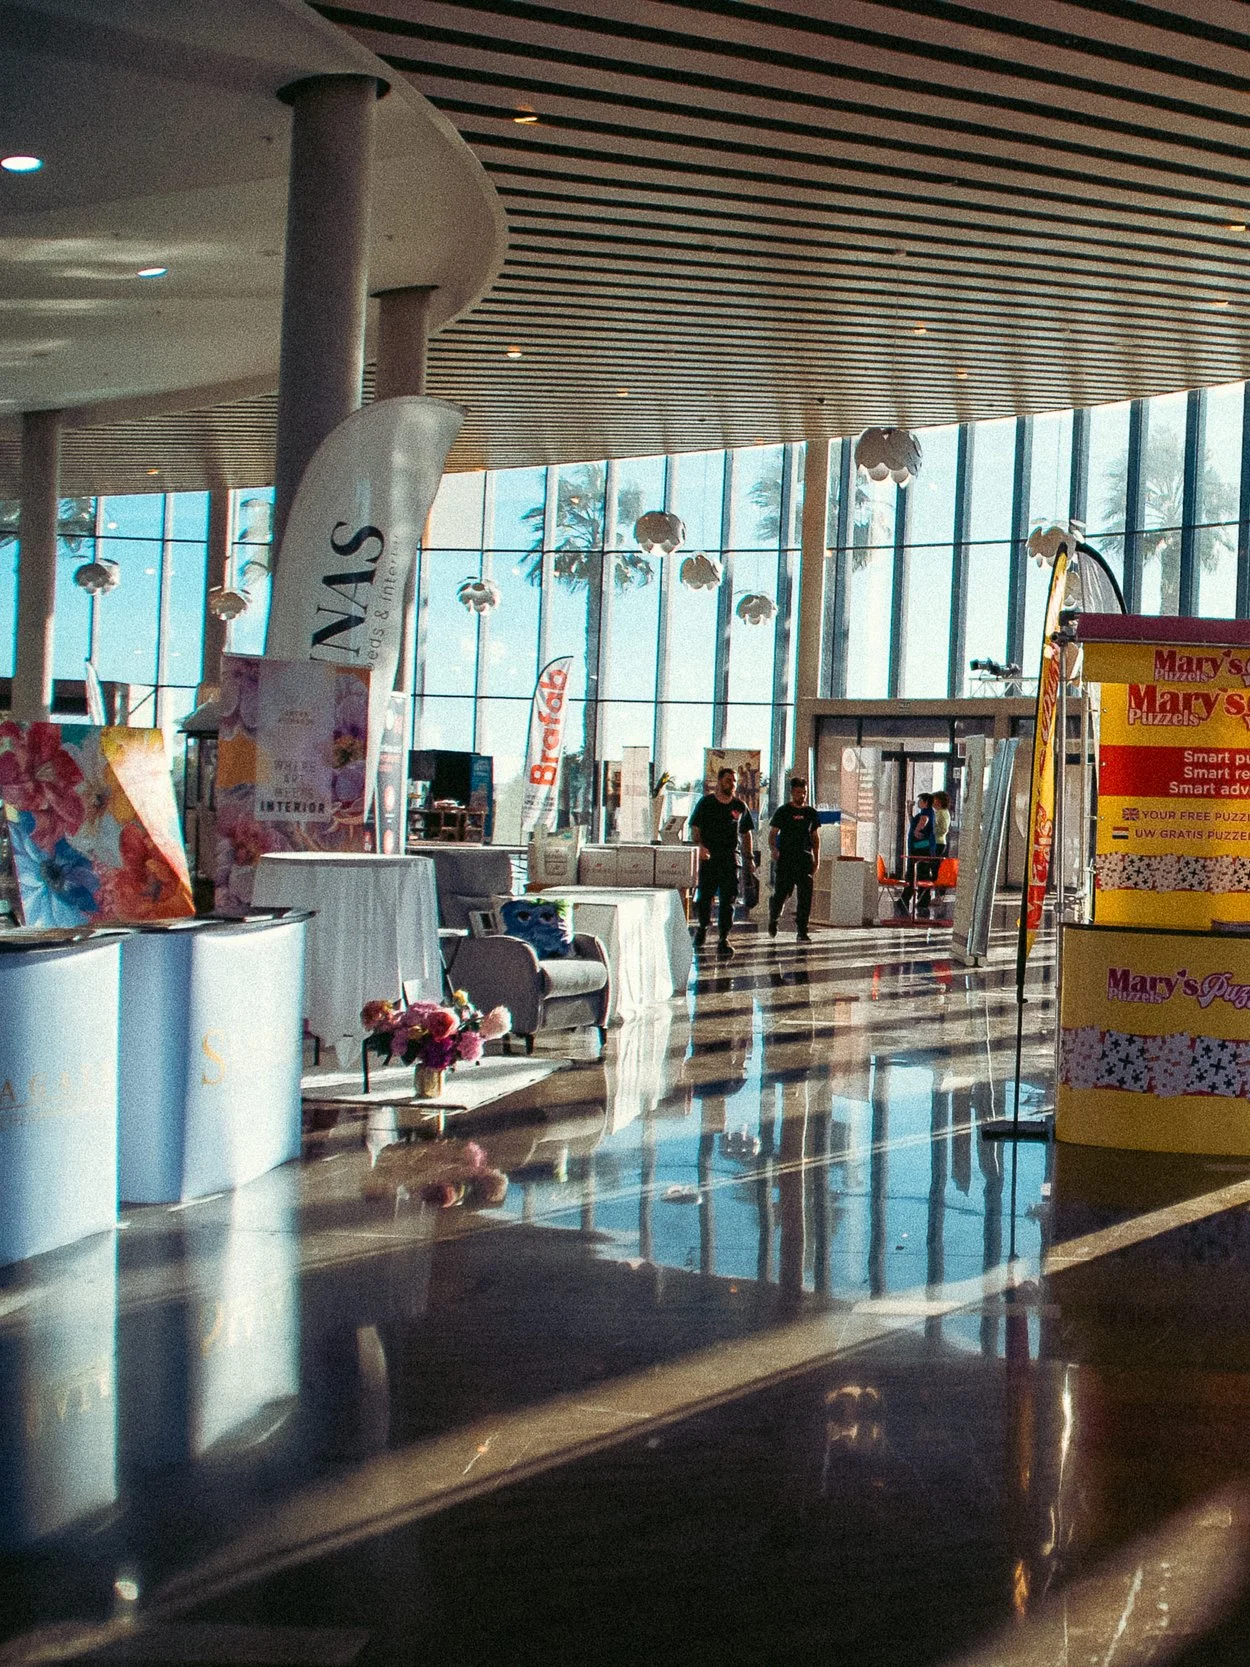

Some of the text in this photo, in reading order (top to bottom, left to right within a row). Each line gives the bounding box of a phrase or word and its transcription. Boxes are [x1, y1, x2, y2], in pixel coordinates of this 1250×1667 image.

[310, 521, 384, 661] NAS
[375, 609, 389, 620] &
[1154, 649, 1244, 679] Mary's
[1127, 684, 1246, 722] Mary's
[1128, 707, 1200, 727] Puzzels
[530, 669, 567, 786] Brafab
[1184, 751, 1230, 763] Smart
[1184, 767, 1230, 779] Smart
[1169, 782, 1215, 794] Smart
[260, 801, 326, 814] INTERIOR
[1142, 810, 1176, 820] YOUR
[1180, 811, 1211, 821] FREE
[1135, 829, 1156, 839] UW
[1160, 830, 1204, 840] GRATIS
[1108, 968, 1199, 999] Mary's
